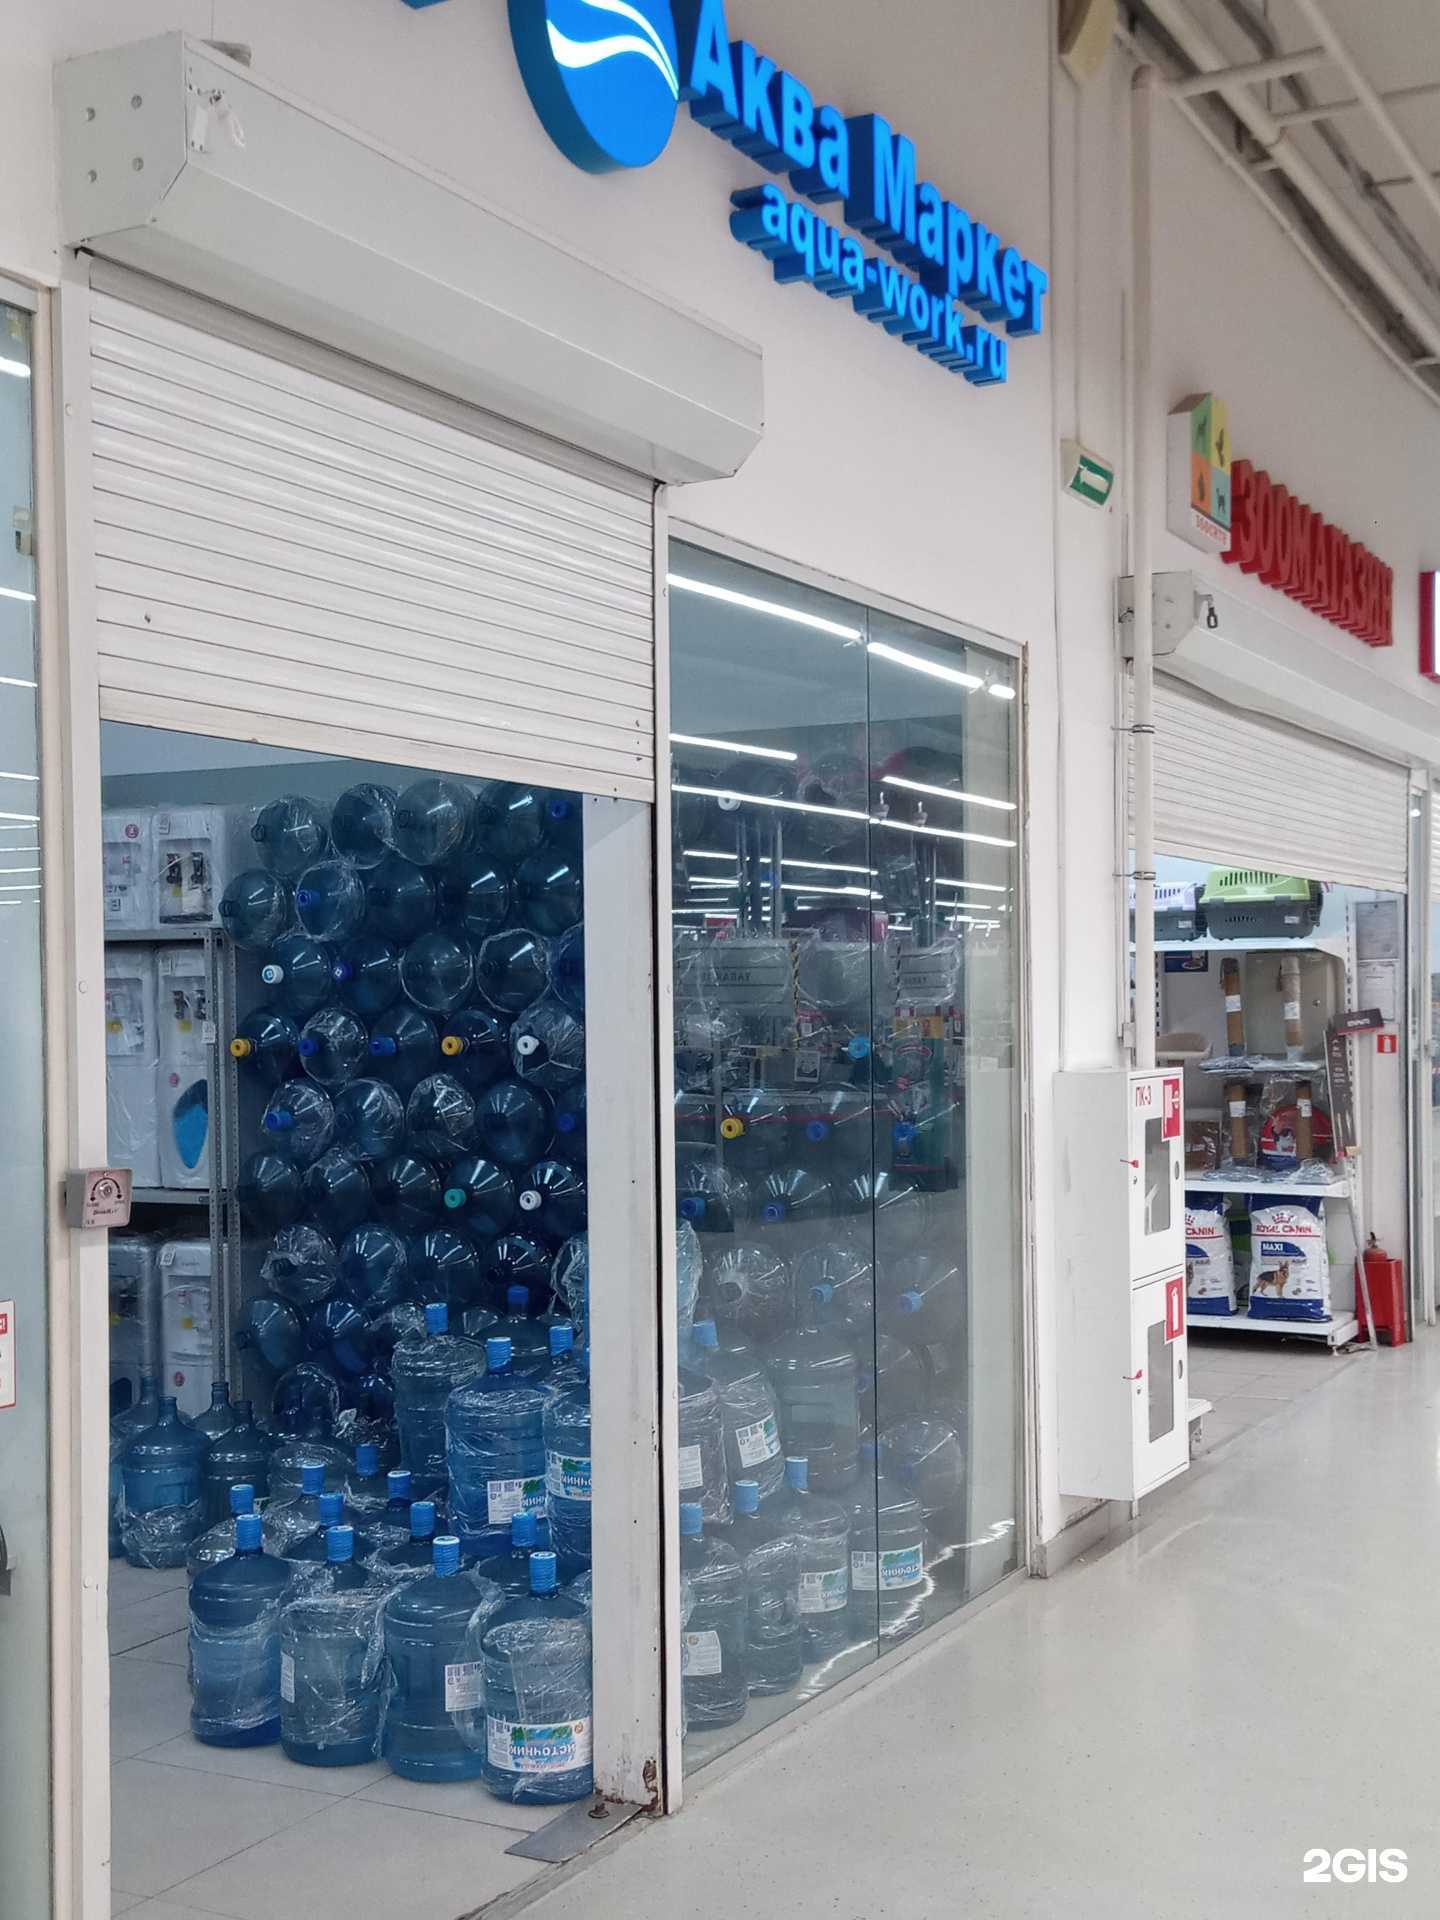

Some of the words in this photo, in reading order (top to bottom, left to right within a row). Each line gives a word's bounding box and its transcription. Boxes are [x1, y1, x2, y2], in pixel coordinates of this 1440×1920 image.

[690, 0, 850, 200] Аква
[868, 113, 1048, 334] Маркет
[756, 182, 1008, 383] aqua-work.ru
[1262, 1243, 1284, 1251] MAXI
[510, 1742, 578, 1757] ИСТОЧНИК
